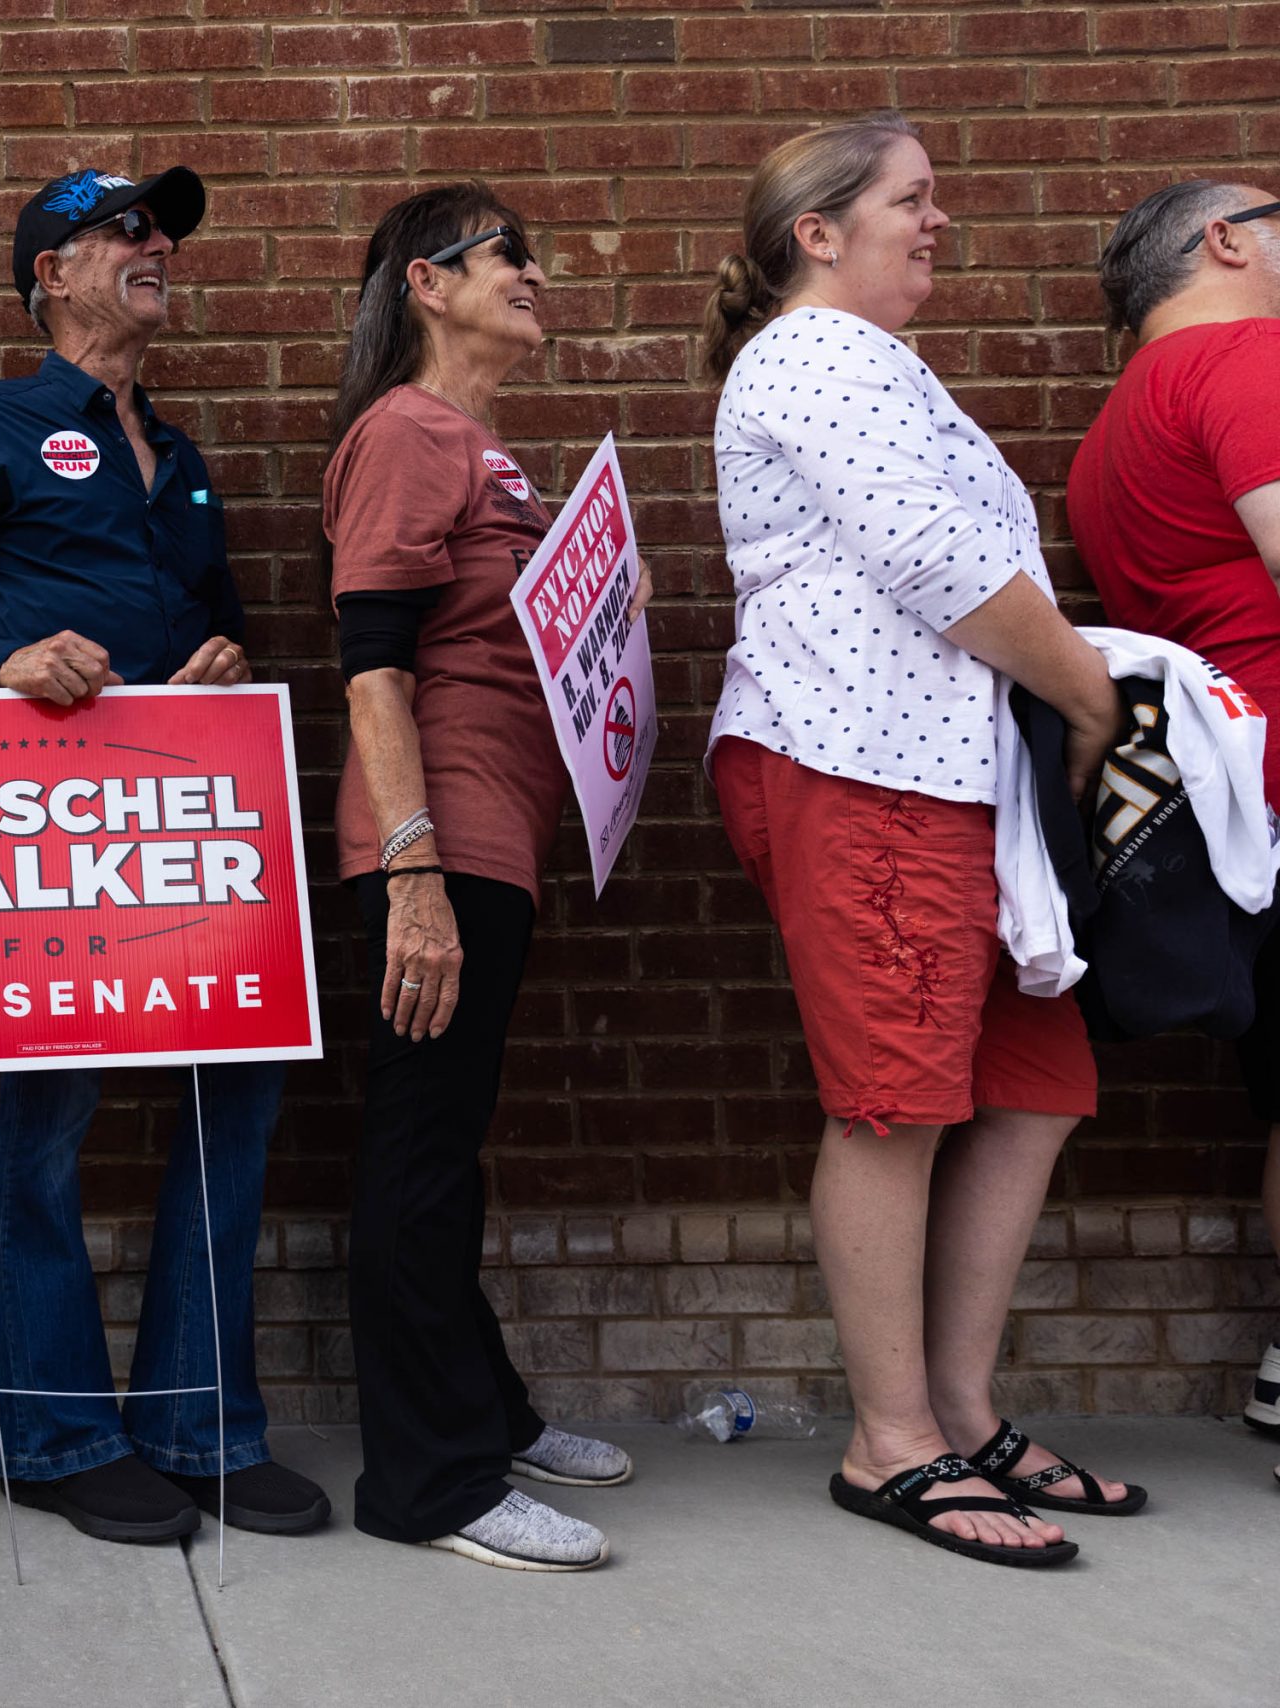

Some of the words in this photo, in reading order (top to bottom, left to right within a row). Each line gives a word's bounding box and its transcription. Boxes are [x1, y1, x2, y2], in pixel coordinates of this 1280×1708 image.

[44, 451, 97, 459] HERSCHEL
[49, 439, 87, 451] RUN
[53, 461, 91, 472] RUN
[485, 458, 509, 470] RUN
[502, 480, 525, 492] RUN
[532, 475, 616, 631] EVICTION
[554, 525, 617, 650] NOTICE
[561, 673, 581, 712] R.
[577, 559, 630, 680] WARNOCK
[572, 682, 600, 744] NOV.
[598, 656, 614, 690] 8,
[1152, 790, 1188, 826] UTDOOR
[1107, 826, 1153, 878] ADVENTURE
[4, 935, 107, 959] FOR
[3, 974, 263, 1018] SENATE
